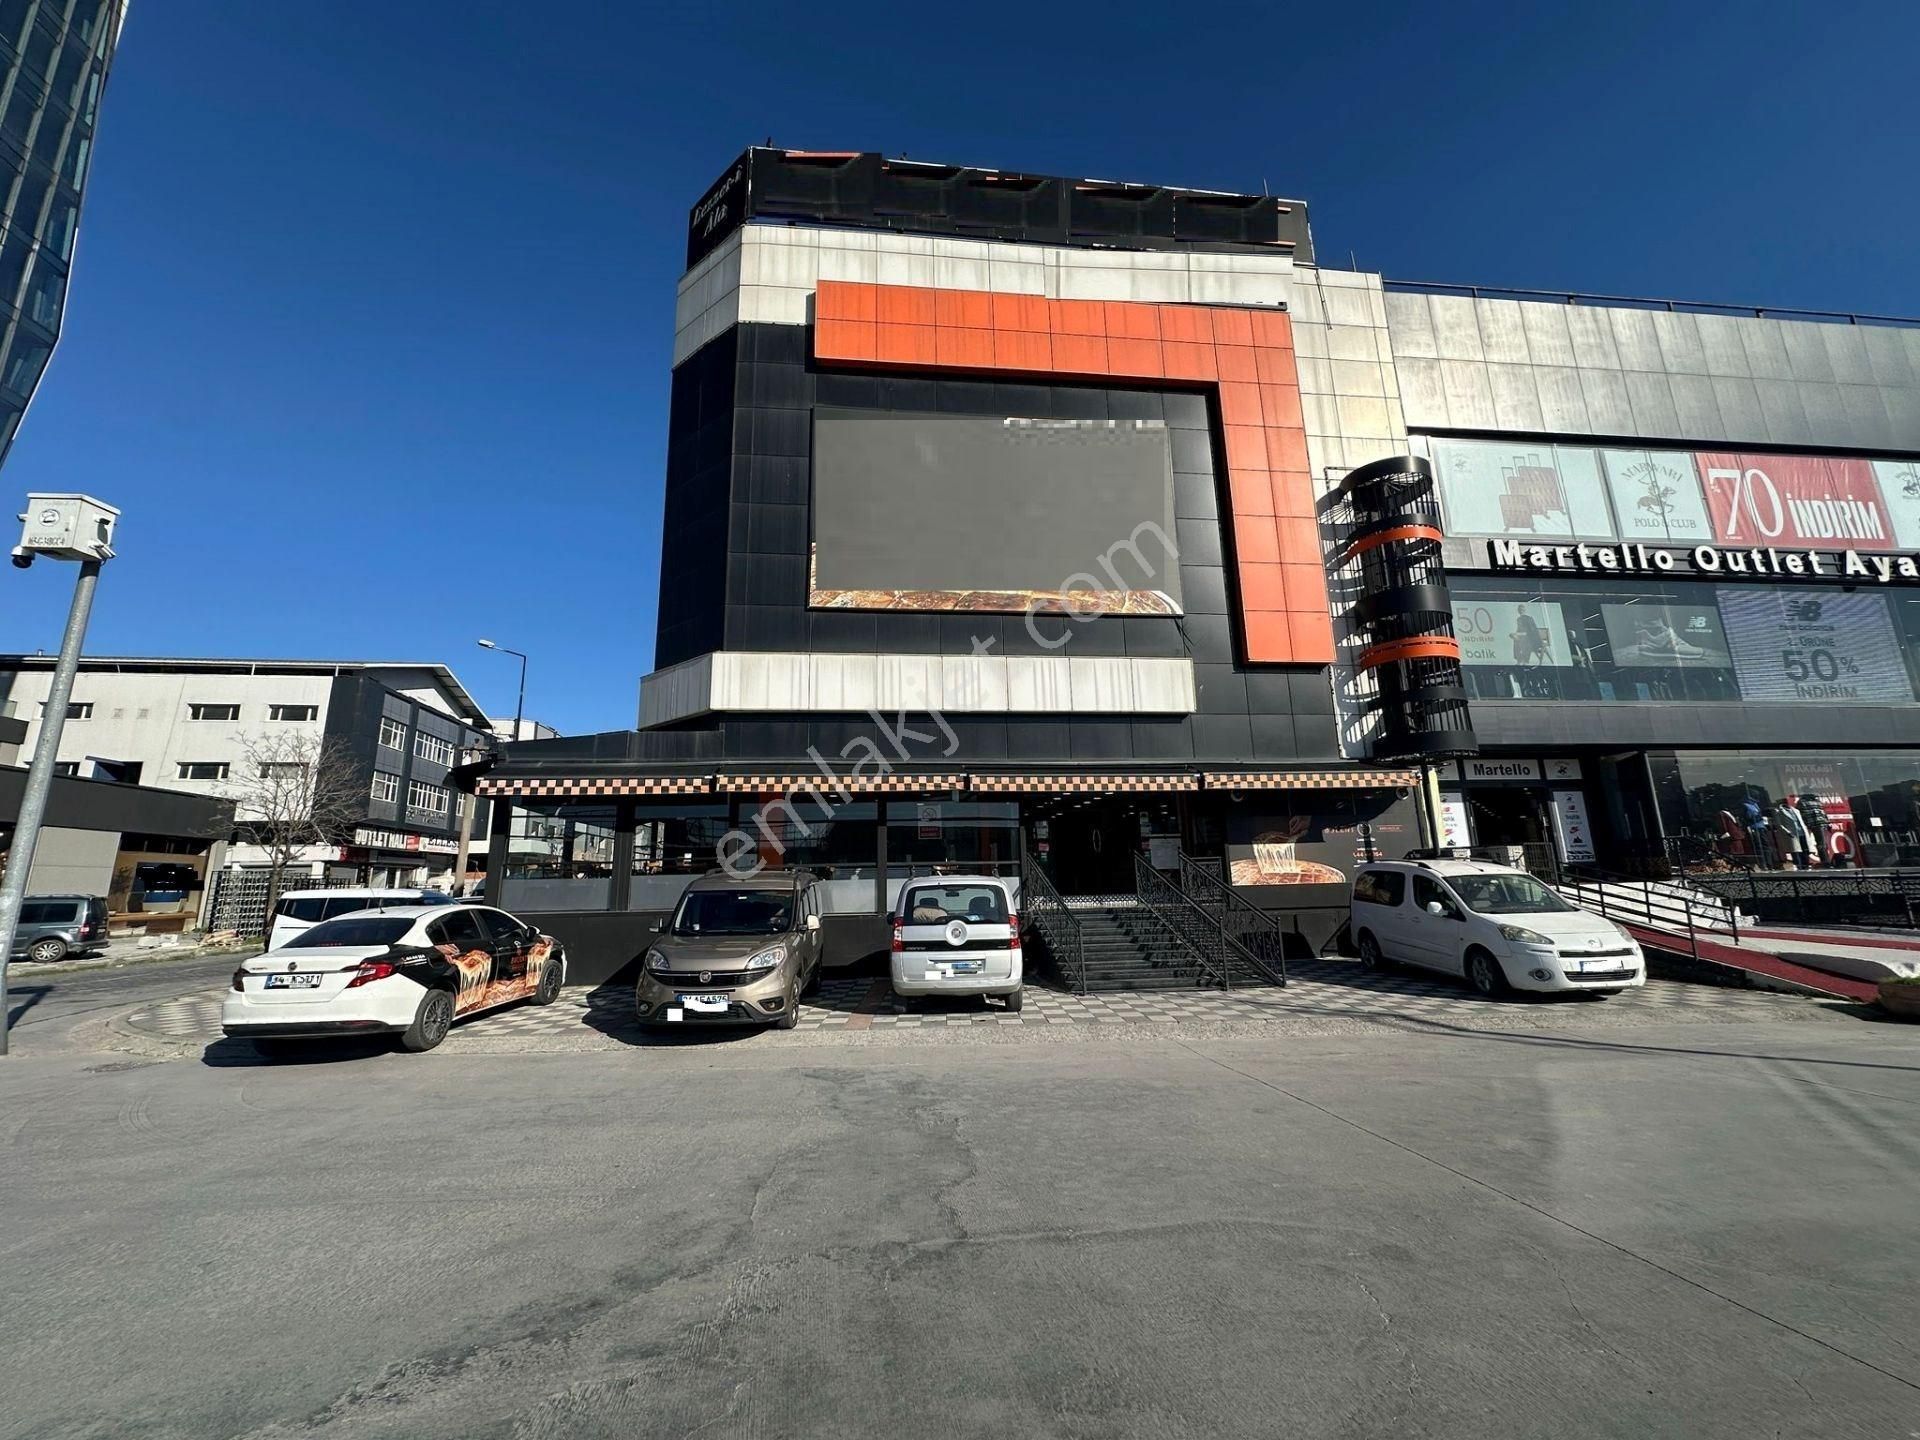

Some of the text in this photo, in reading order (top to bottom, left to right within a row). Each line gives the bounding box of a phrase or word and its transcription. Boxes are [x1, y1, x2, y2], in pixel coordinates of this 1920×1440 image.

[1707, 468, 1885, 540] 70 İNDİRİM
[1634, 517, 1660, 528] POLO
[1671, 518, 1697, 529] CLUB
[1495, 539, 1920, 582] Martello Outlet Aya
[1456, 607, 1493, 634] 50
[1466, 648, 1496, 659] batik
[1473, 763, 1531, 776] Martello
[354, 828, 389, 848] OUTLET
